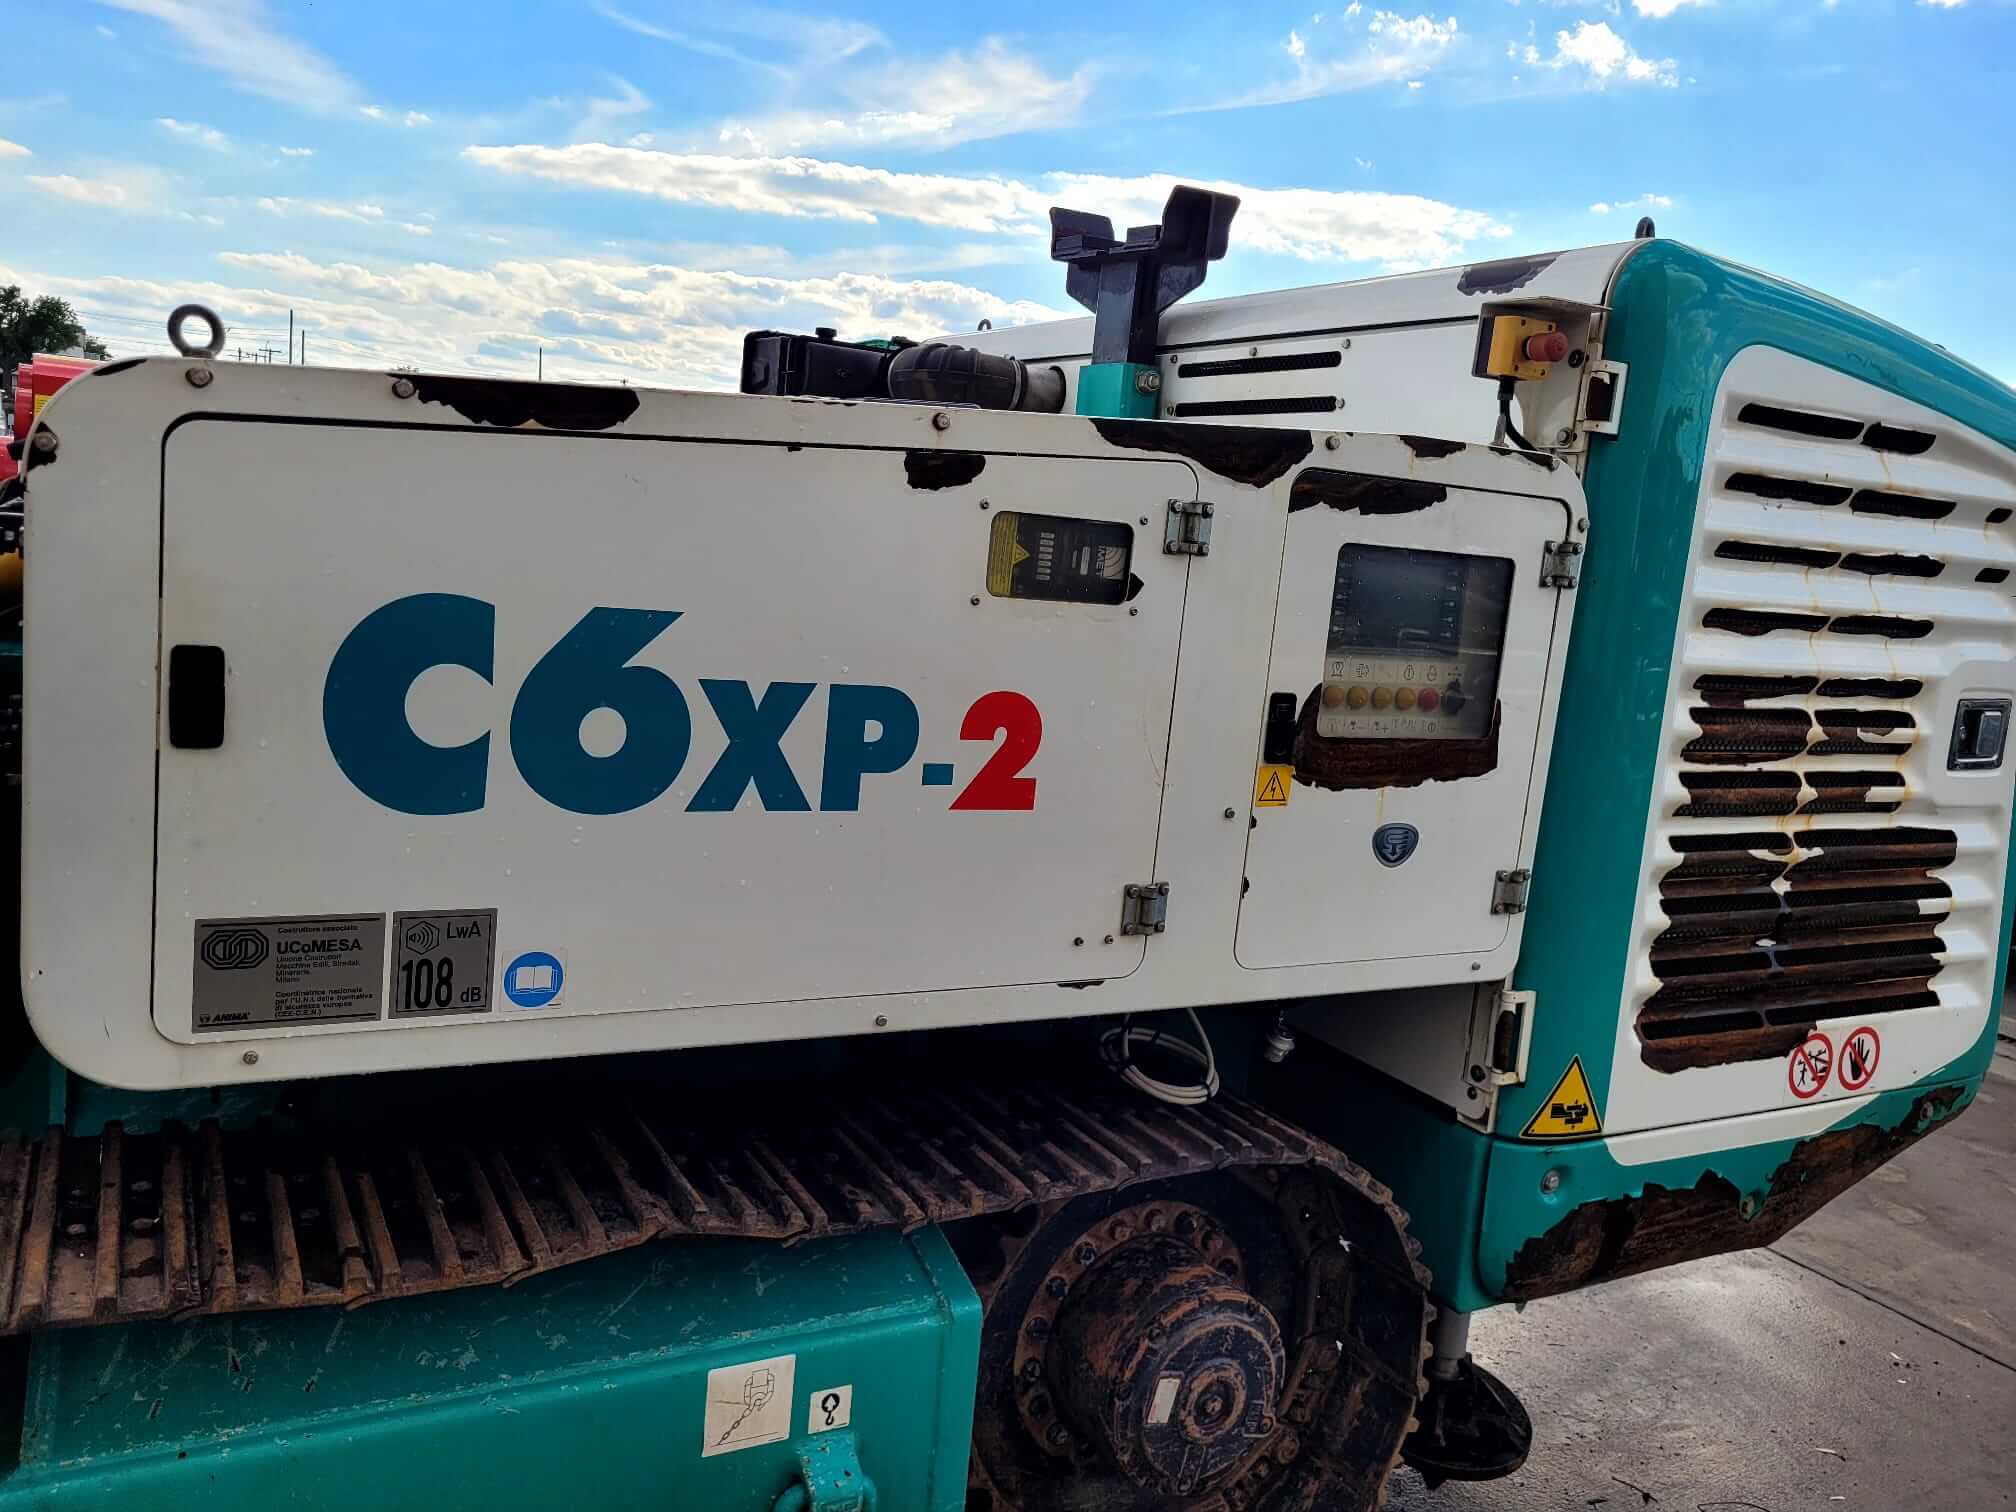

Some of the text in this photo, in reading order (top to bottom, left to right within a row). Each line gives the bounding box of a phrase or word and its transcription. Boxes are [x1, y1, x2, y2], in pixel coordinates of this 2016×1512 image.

[323, 592, 1043, 815] C6XP-2
[276, 938, 362, 955] UCoMESA
[447, 921, 481, 939] LwA
[402, 957, 481, 1009] 108 dB
